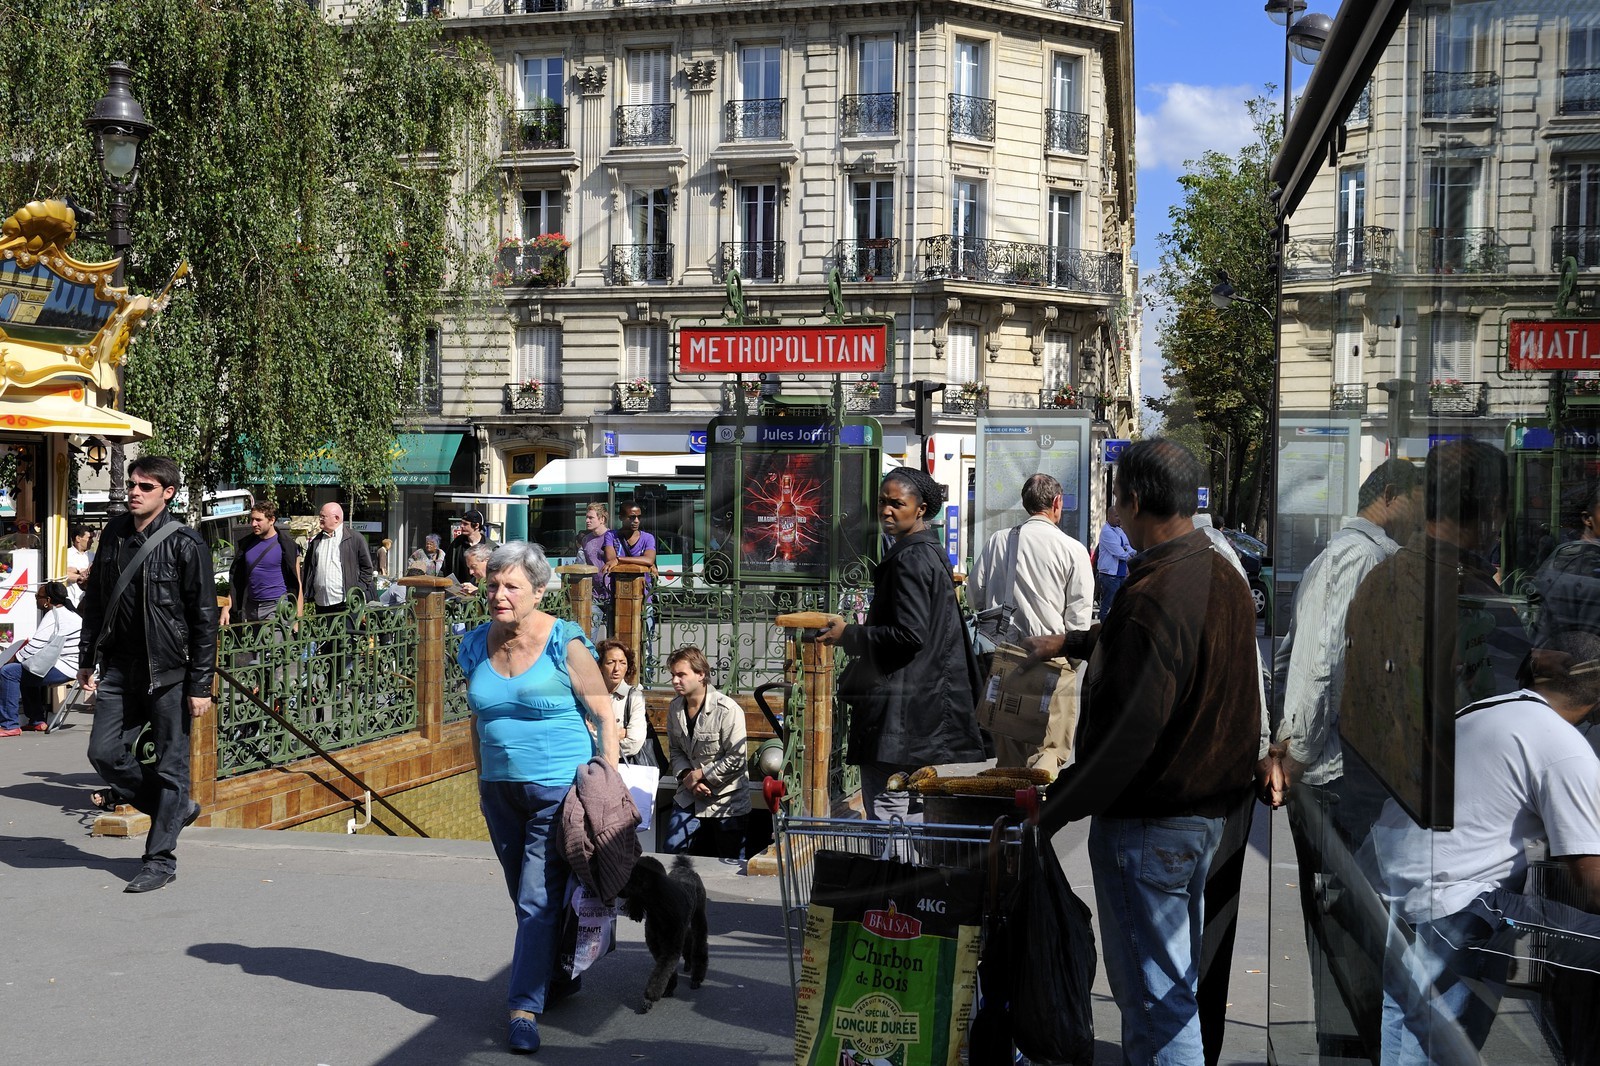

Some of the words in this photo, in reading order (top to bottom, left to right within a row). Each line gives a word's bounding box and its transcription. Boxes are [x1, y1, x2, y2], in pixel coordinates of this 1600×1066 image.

[689, 335, 875, 364] METROPOLITAIN
[762, 428, 794, 441] Jules
[797, 428, 833, 441] Joffri
[916, 898, 946, 914] 4KG
[855, 971, 868, 985] de
[872, 968, 908, 992] Bois
[857, 999, 877, 1013] PRODUIT
[878, 999, 898, 1015] NATUREL
[865, 1008, 890, 1018] SPÉCIAL
[836, 1016, 878, 1033] LONGUE
[881, 1019, 917, 1035] DURÉE
[857, 1038, 872, 1053] BOIS
[875, 1040, 894, 1053] DURS
